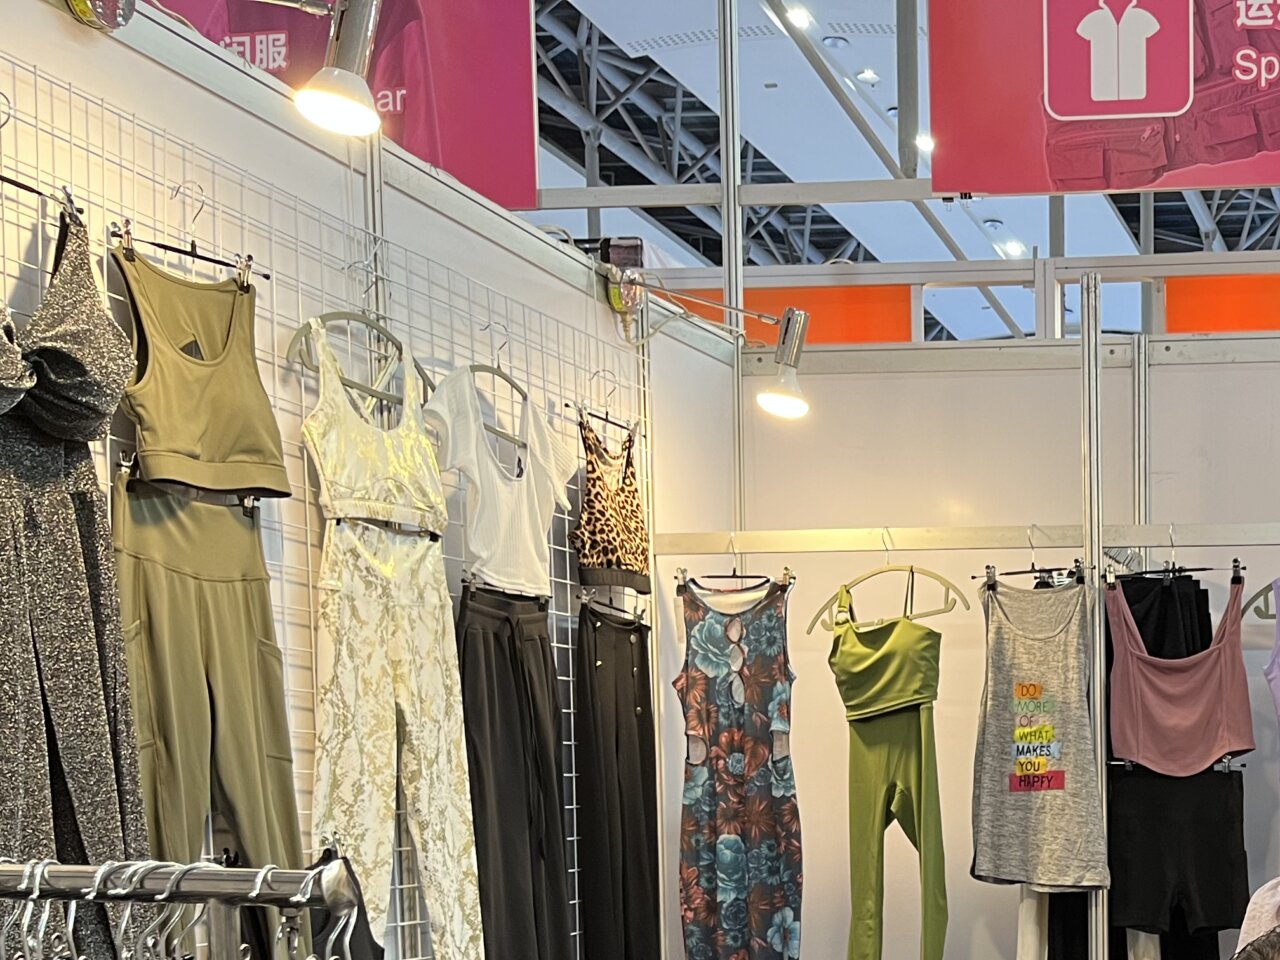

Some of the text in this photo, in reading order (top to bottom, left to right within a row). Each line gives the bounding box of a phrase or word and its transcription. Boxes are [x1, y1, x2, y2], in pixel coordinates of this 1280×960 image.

[1021, 684, 1037, 697] DO
[1017, 701, 1048, 713] MORE
[1019, 715, 1035, 728] OF
[1019, 731, 1049, 742] WHAT
[1016, 745, 1051, 757] MAKES
[1019, 761, 1041, 772] YOU
[1019, 776, 1054, 788] HAPPY
